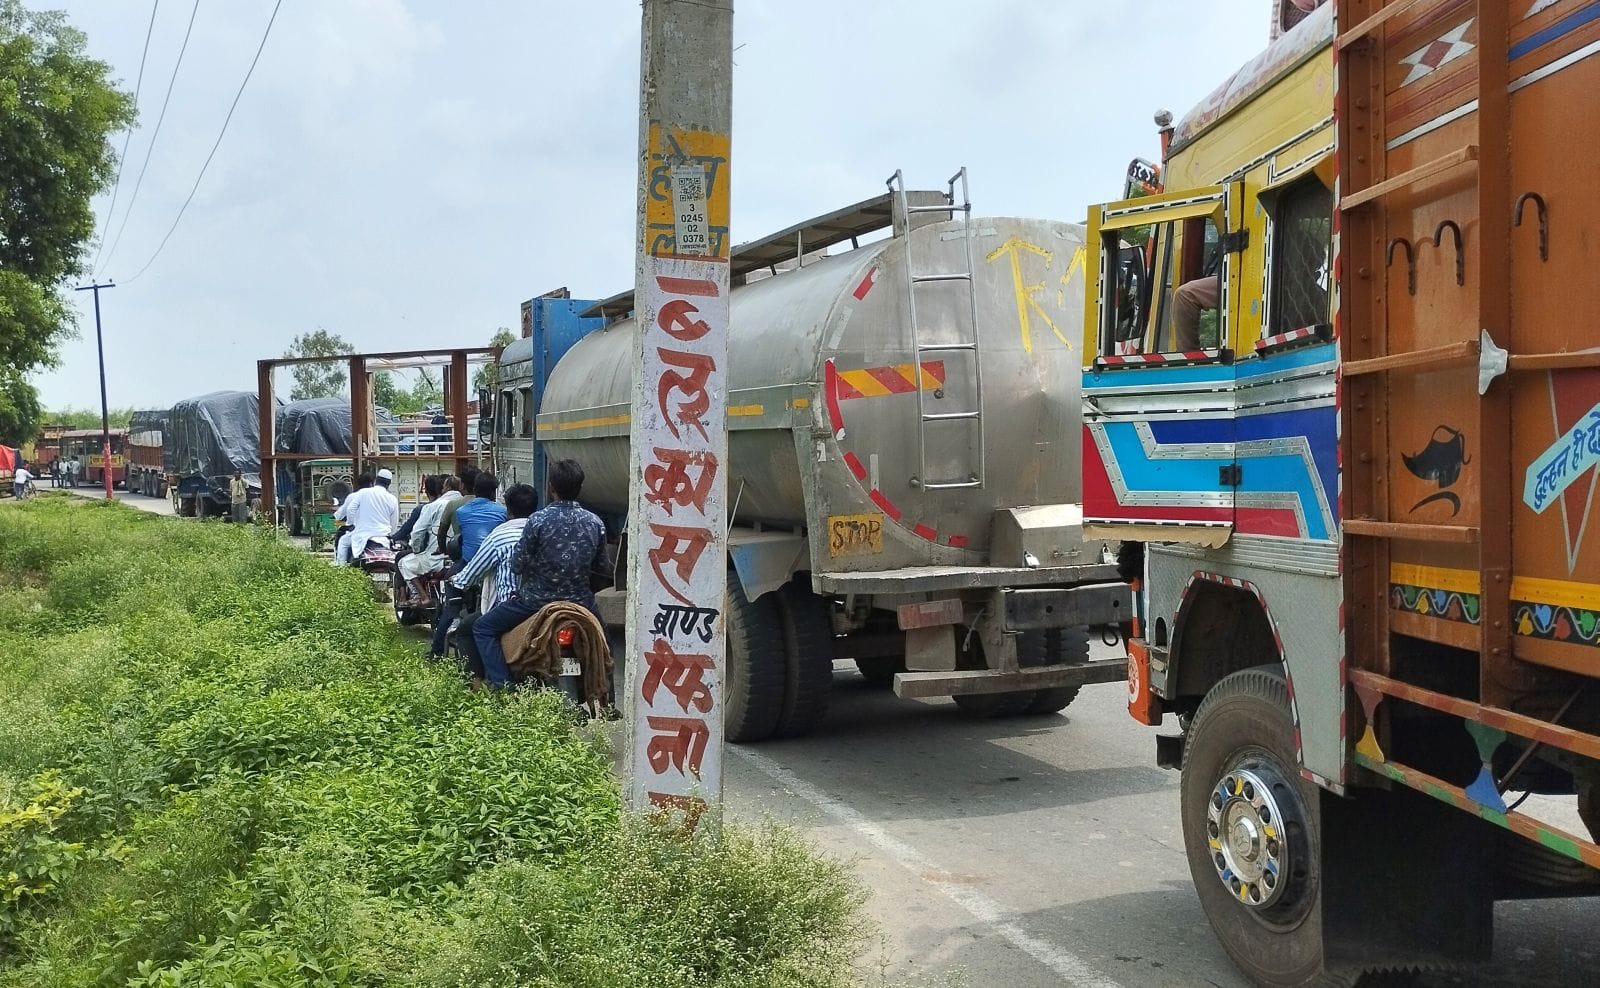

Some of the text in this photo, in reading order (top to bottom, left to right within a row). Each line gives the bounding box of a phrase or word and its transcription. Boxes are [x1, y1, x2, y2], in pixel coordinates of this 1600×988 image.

[689, 203, 695, 212] 3
[681, 214, 703, 223] 0245
[687, 224, 698, 233] 02
[683, 234, 704, 243] 0378
[832, 520, 881, 549] STOP
